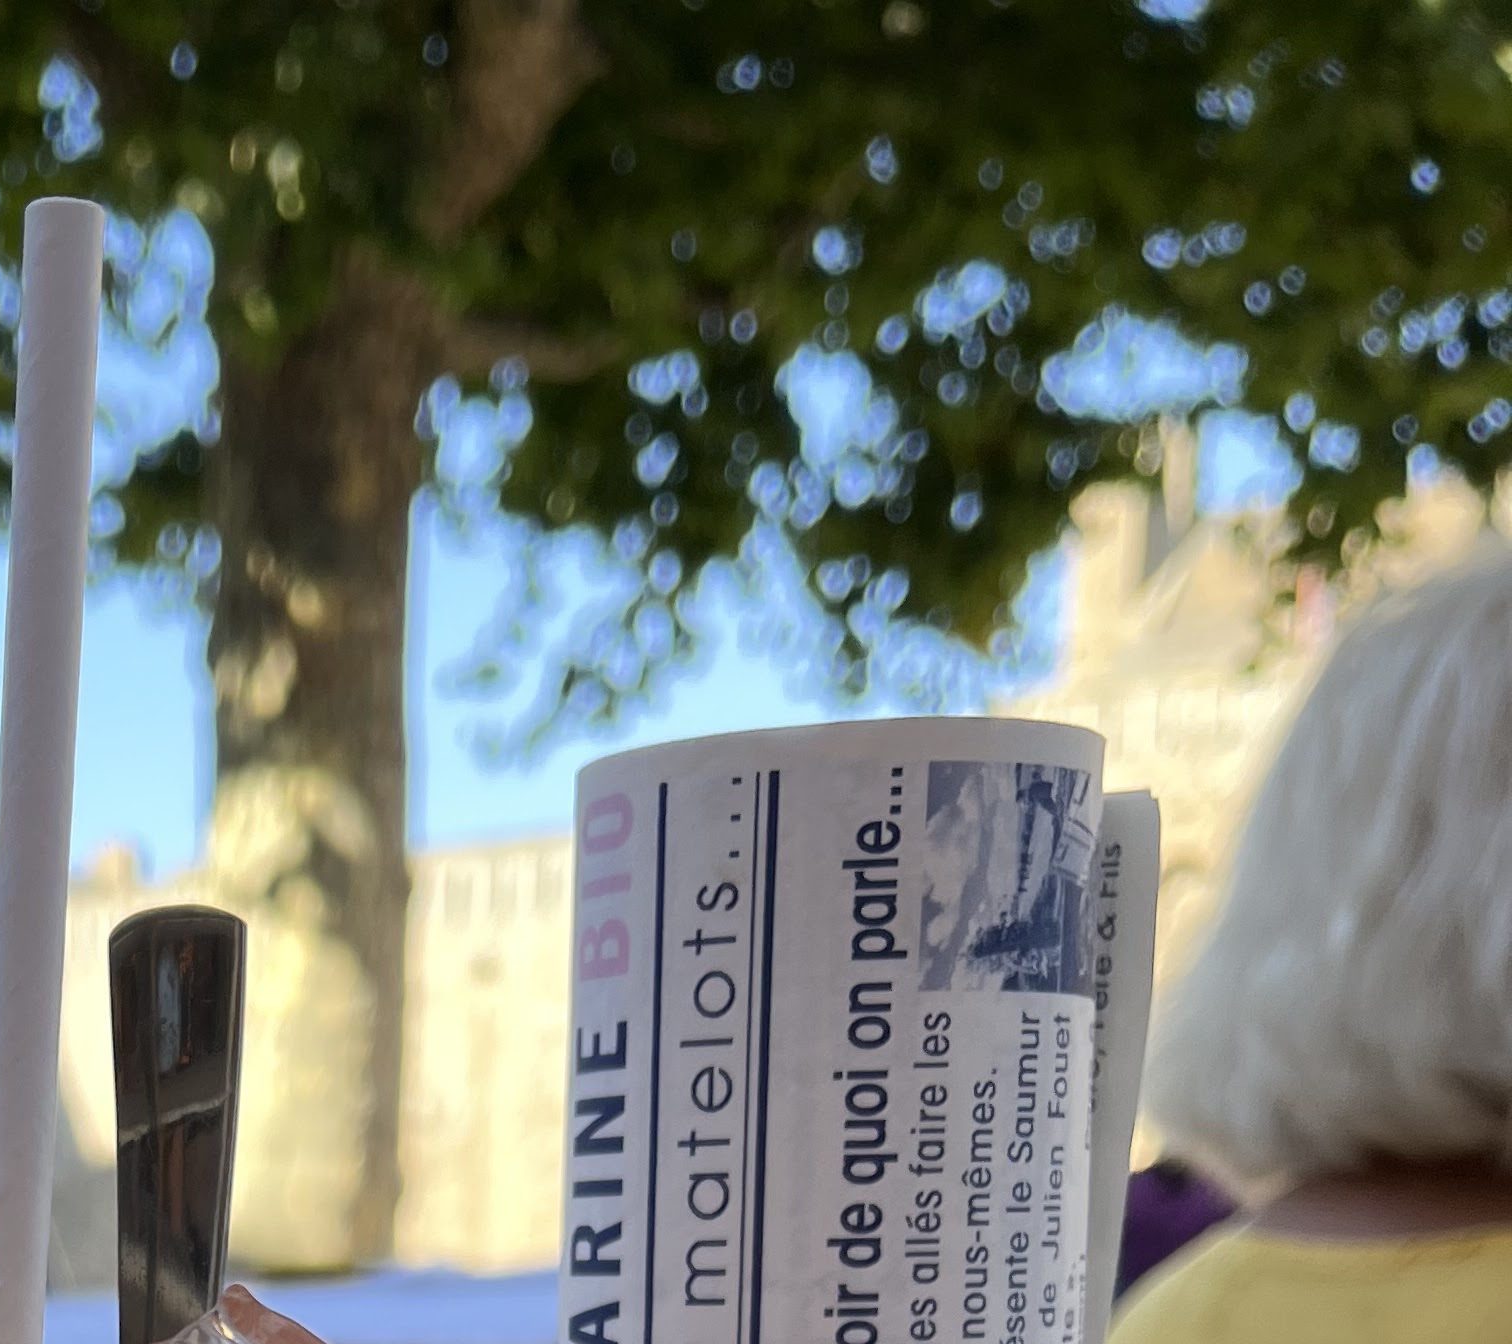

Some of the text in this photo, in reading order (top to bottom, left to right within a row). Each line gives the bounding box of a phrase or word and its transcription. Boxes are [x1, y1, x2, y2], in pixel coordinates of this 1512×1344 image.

[577, 791, 634, 981] BIO
[841, 764, 908, 961] parle...
[676, 775, 743, 1306] matelots...
[847, 980, 893, 1049] on
[912, 1010, 952, 1069] les
[1046, 1012, 1072, 1118] Fouet
[833, 1068, 898, 1184] quoi
[908, 1083, 949, 1176] faire
[1007, 1009, 1041, 1164] Saumur
[826, 1201, 884, 1268] de
[903, 1188, 944, 1284] allés
[960, 1065, 998, 1340] nous-mêmes.
[1004, 1179, 1034, 1214] le
[1039, 1143, 1066, 1260] Julien
[1038, 1281, 1057, 1327] de
